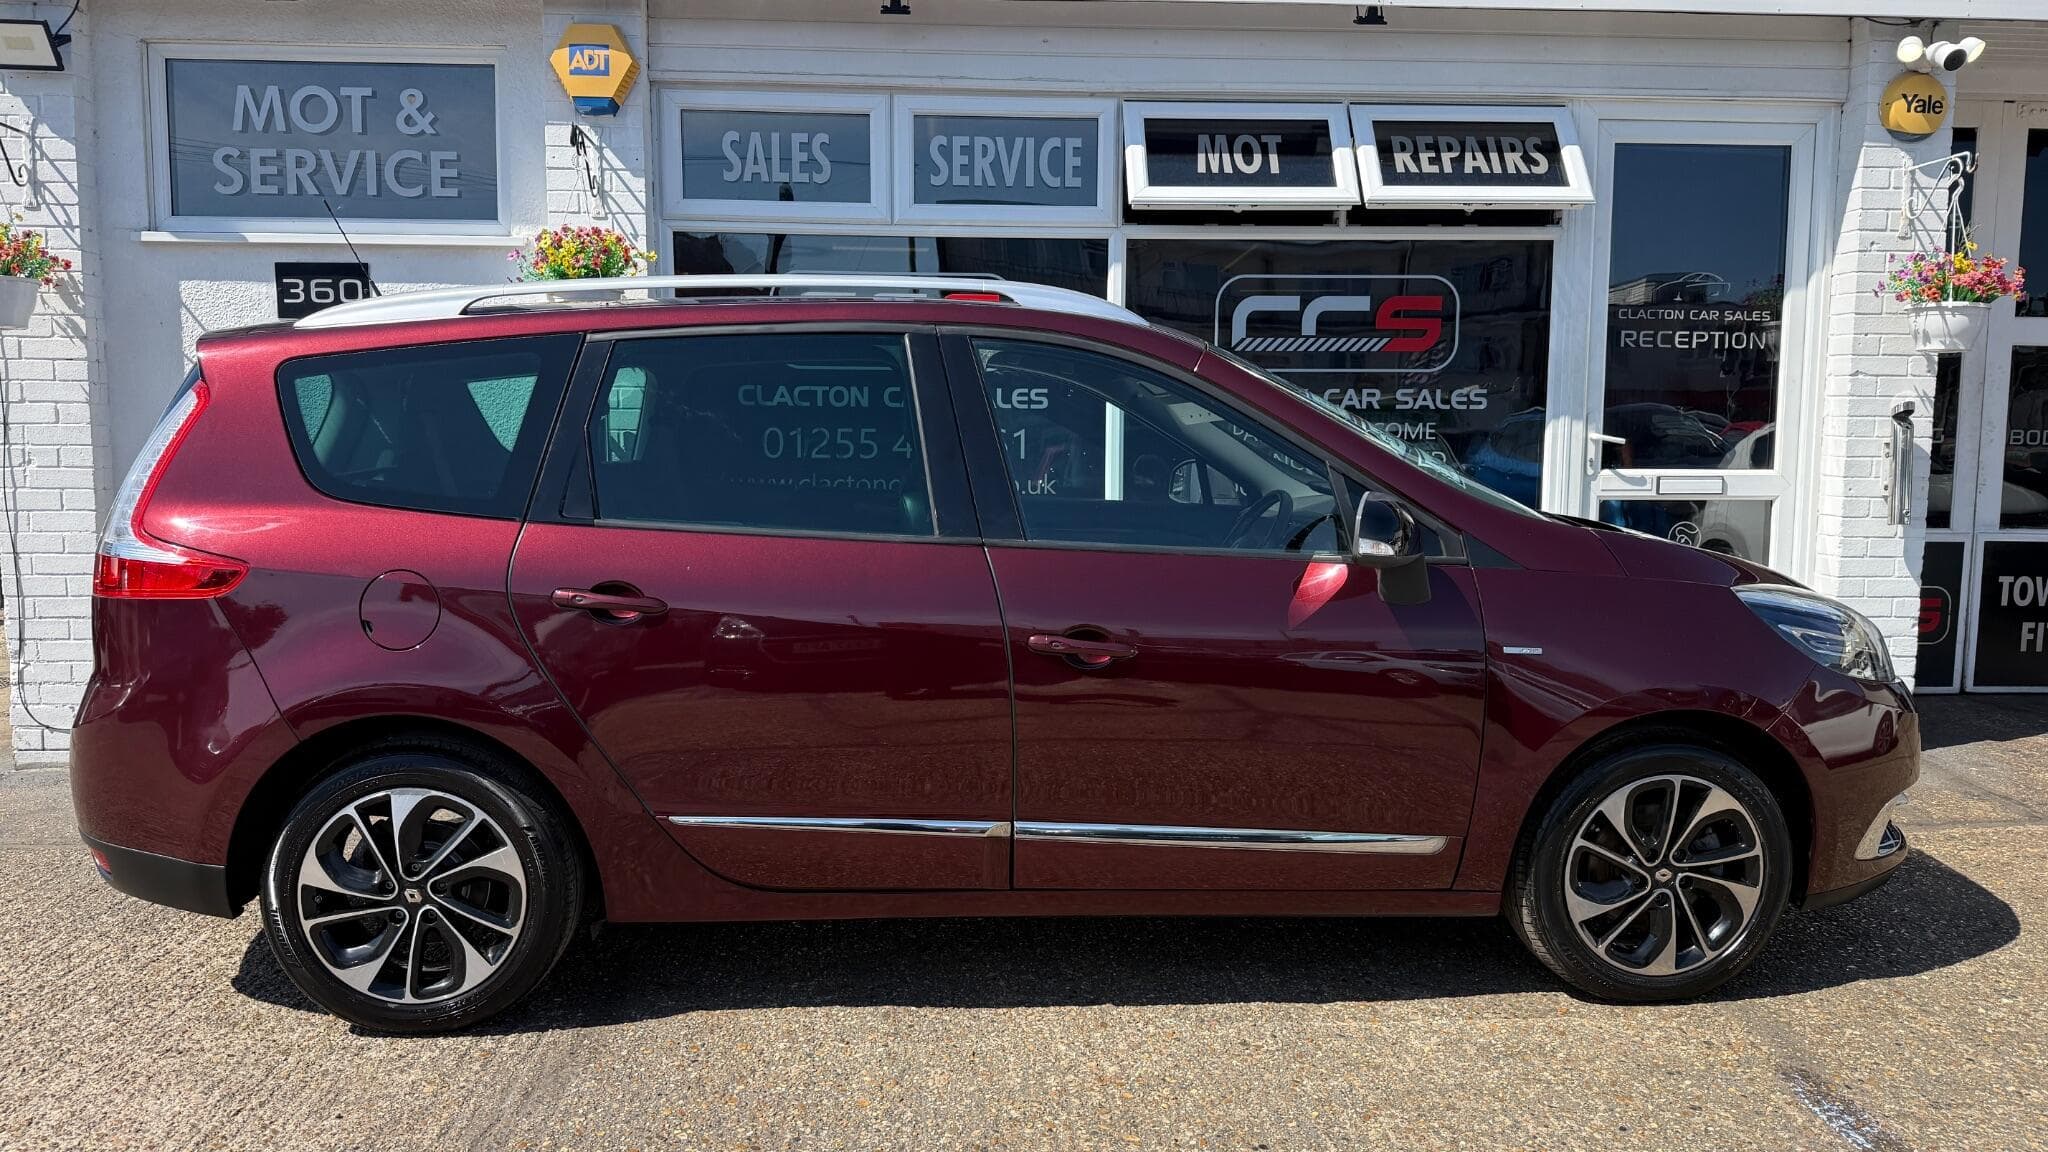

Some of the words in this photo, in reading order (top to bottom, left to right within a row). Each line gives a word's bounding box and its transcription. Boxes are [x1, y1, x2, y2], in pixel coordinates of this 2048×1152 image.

[569, 49, 610, 71] ADT
[232, 85, 376, 135] MOT
[395, 88, 439, 135] &
[1902, 93, 1944, 115] Yale
[722, 130, 832, 185] SALES
[929, 134, 1083, 188] SERVICE
[1197, 133, 1283, 175] MOT
[1390, 134, 1550, 176] REPAIRS
[212, 146, 461, 198] SERVICE
[282, 278, 363, 304] 360
[1618, 308, 1685, 320] CLACTON
[1690, 309, 1720, 321] CAR
[1724, 310, 1771, 322] SALES
[1620, 330, 1767, 350] RECEPTION
[738, 384, 870, 408] CLACTON
[1395, 388, 1488, 410] SALES
[763, 426, 879, 460] 01255
